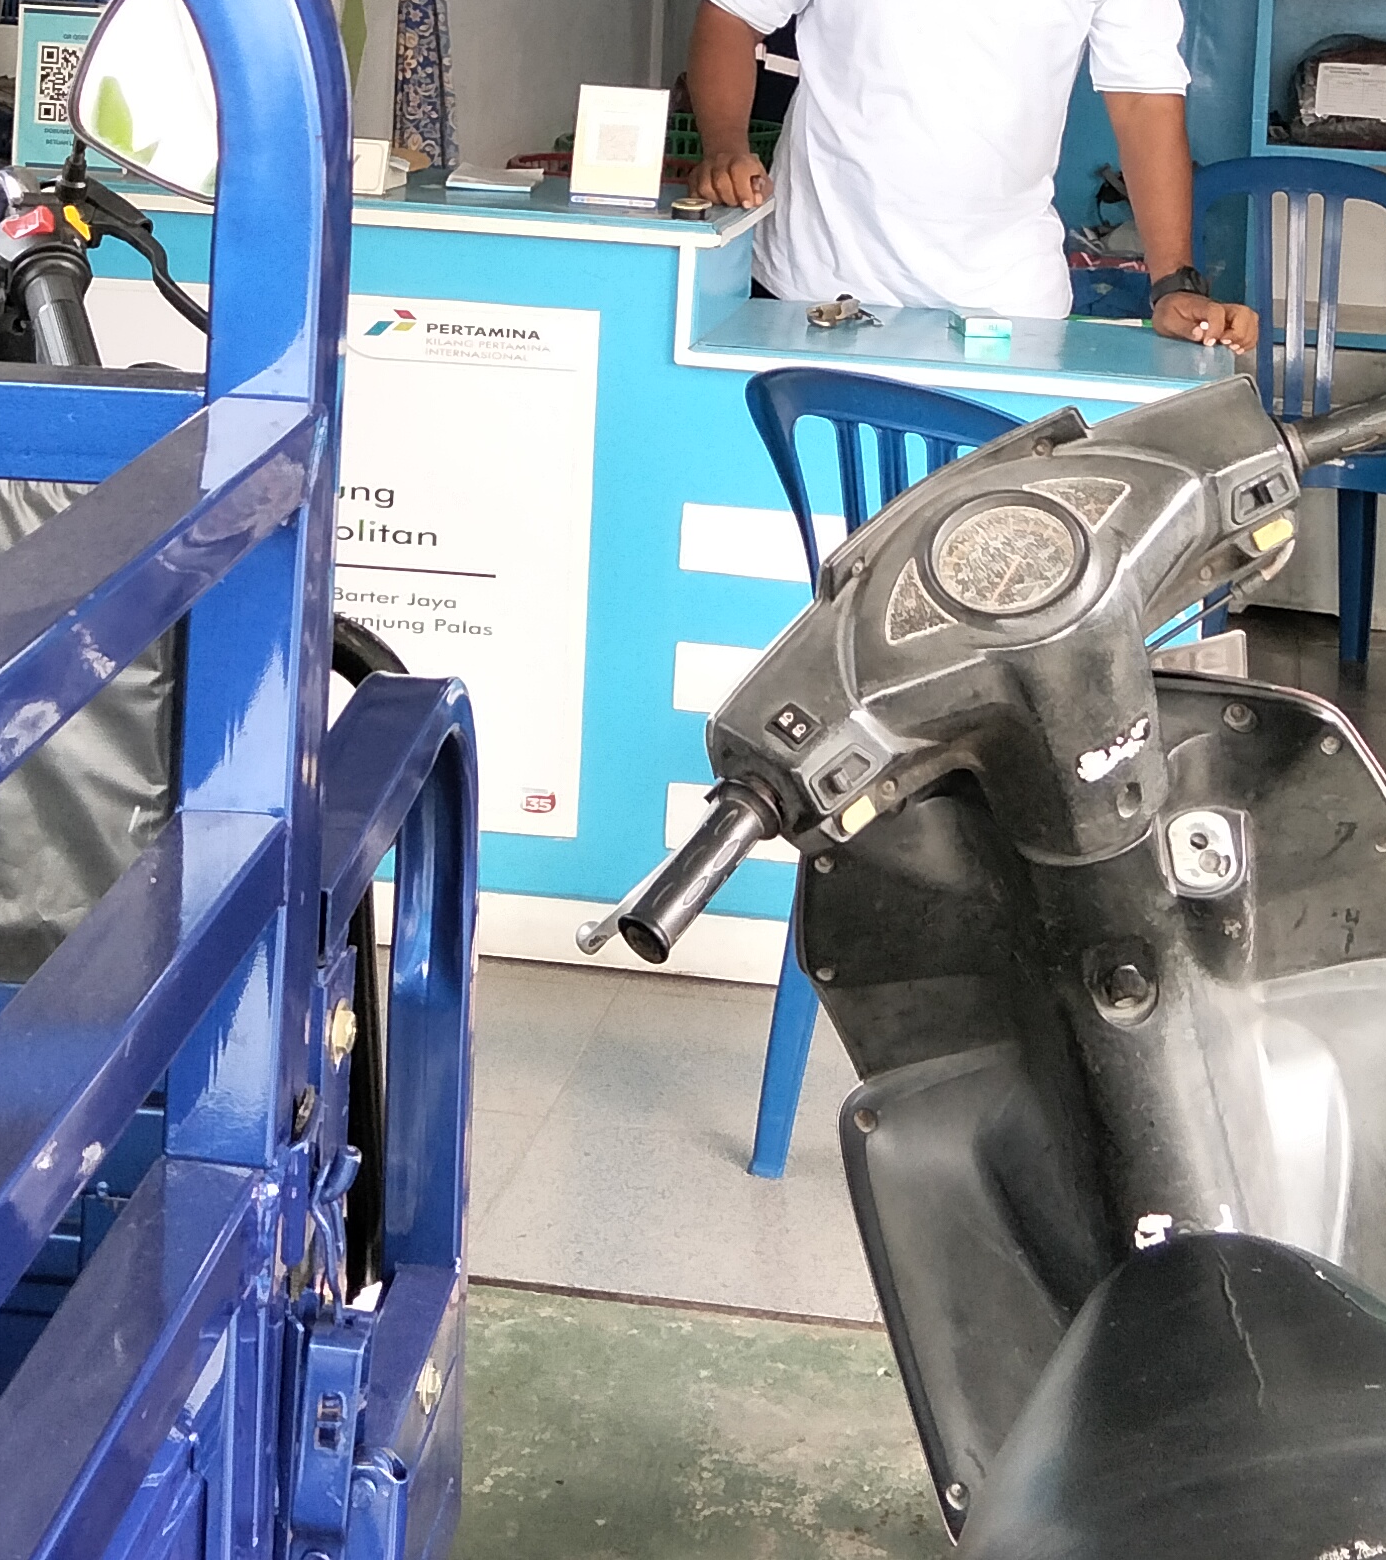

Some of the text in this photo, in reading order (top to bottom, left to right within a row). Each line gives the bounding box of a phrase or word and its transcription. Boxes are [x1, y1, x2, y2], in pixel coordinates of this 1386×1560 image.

[426, 323, 541, 340] PERTAMINA
[425, 337, 551, 352] KILANG PERTAMINA
[425, 348, 529, 362] INTERNASIONAL
[333, 587, 457, 611] Barter Jaya
[334, 611, 493, 636] njung Palas
